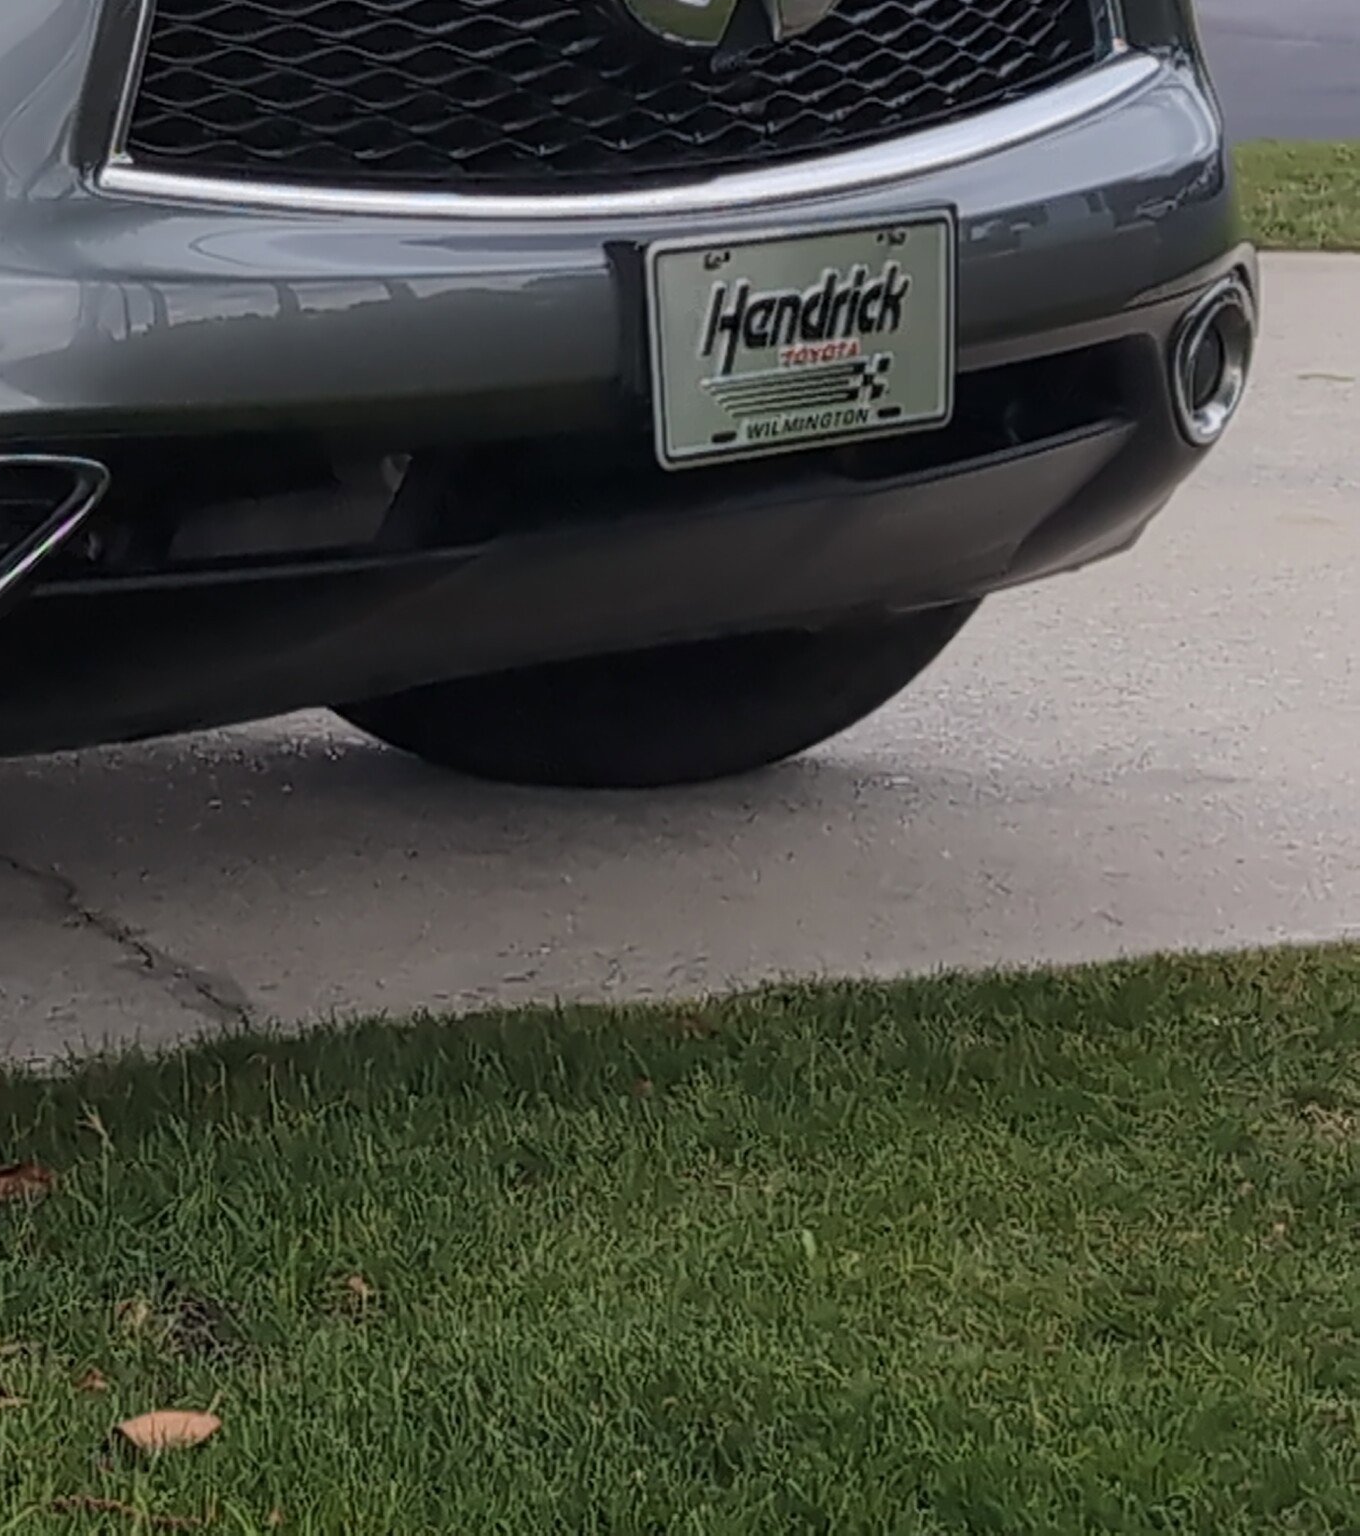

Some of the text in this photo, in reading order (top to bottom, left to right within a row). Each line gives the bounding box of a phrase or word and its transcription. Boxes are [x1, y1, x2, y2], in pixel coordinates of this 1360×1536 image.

[700, 263, 911, 377] Hendrick
[782, 341, 859, 367] TOYOTA
[745, 408, 870, 440] WILMINGTON
